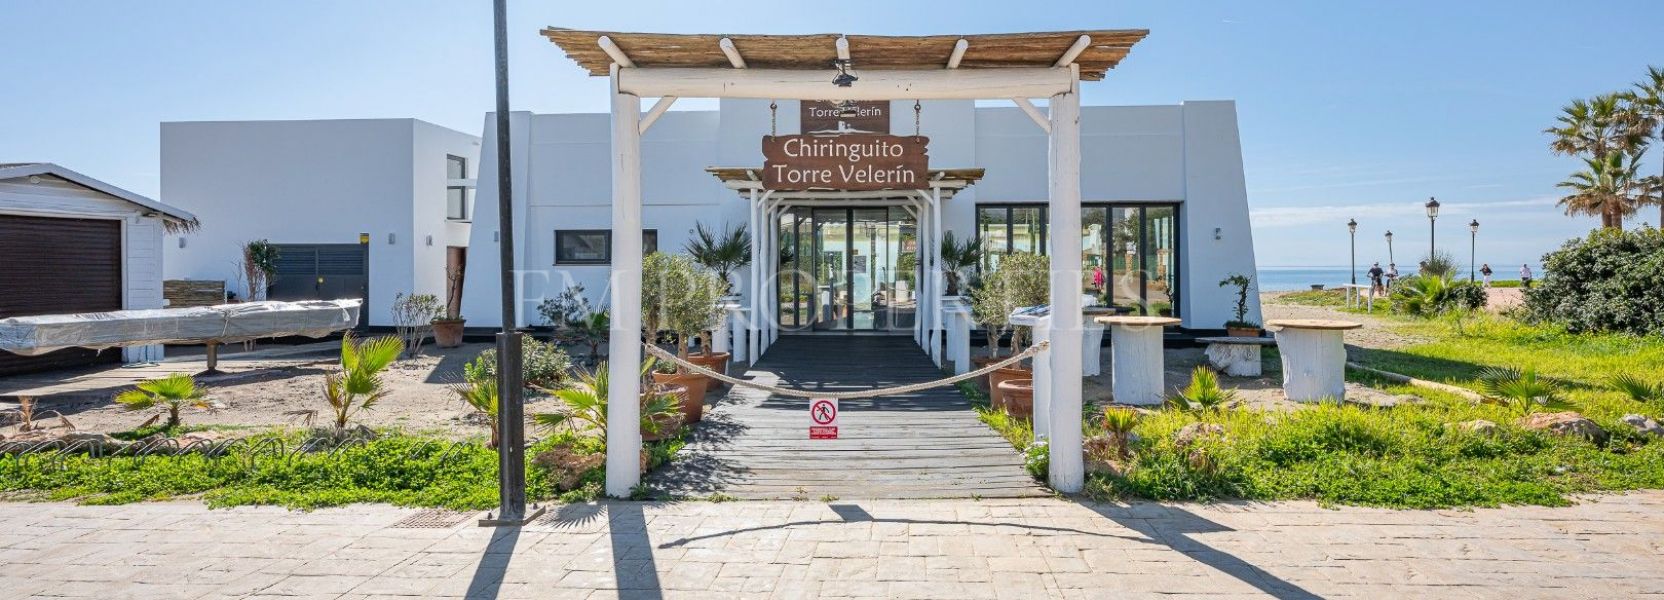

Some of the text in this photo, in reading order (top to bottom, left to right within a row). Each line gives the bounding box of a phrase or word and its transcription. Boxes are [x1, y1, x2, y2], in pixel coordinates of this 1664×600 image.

[808, 106, 839, 117] Torre
[783, 138, 904, 162] Chiringuito
[772, 164, 915, 183] Torre Velerín
